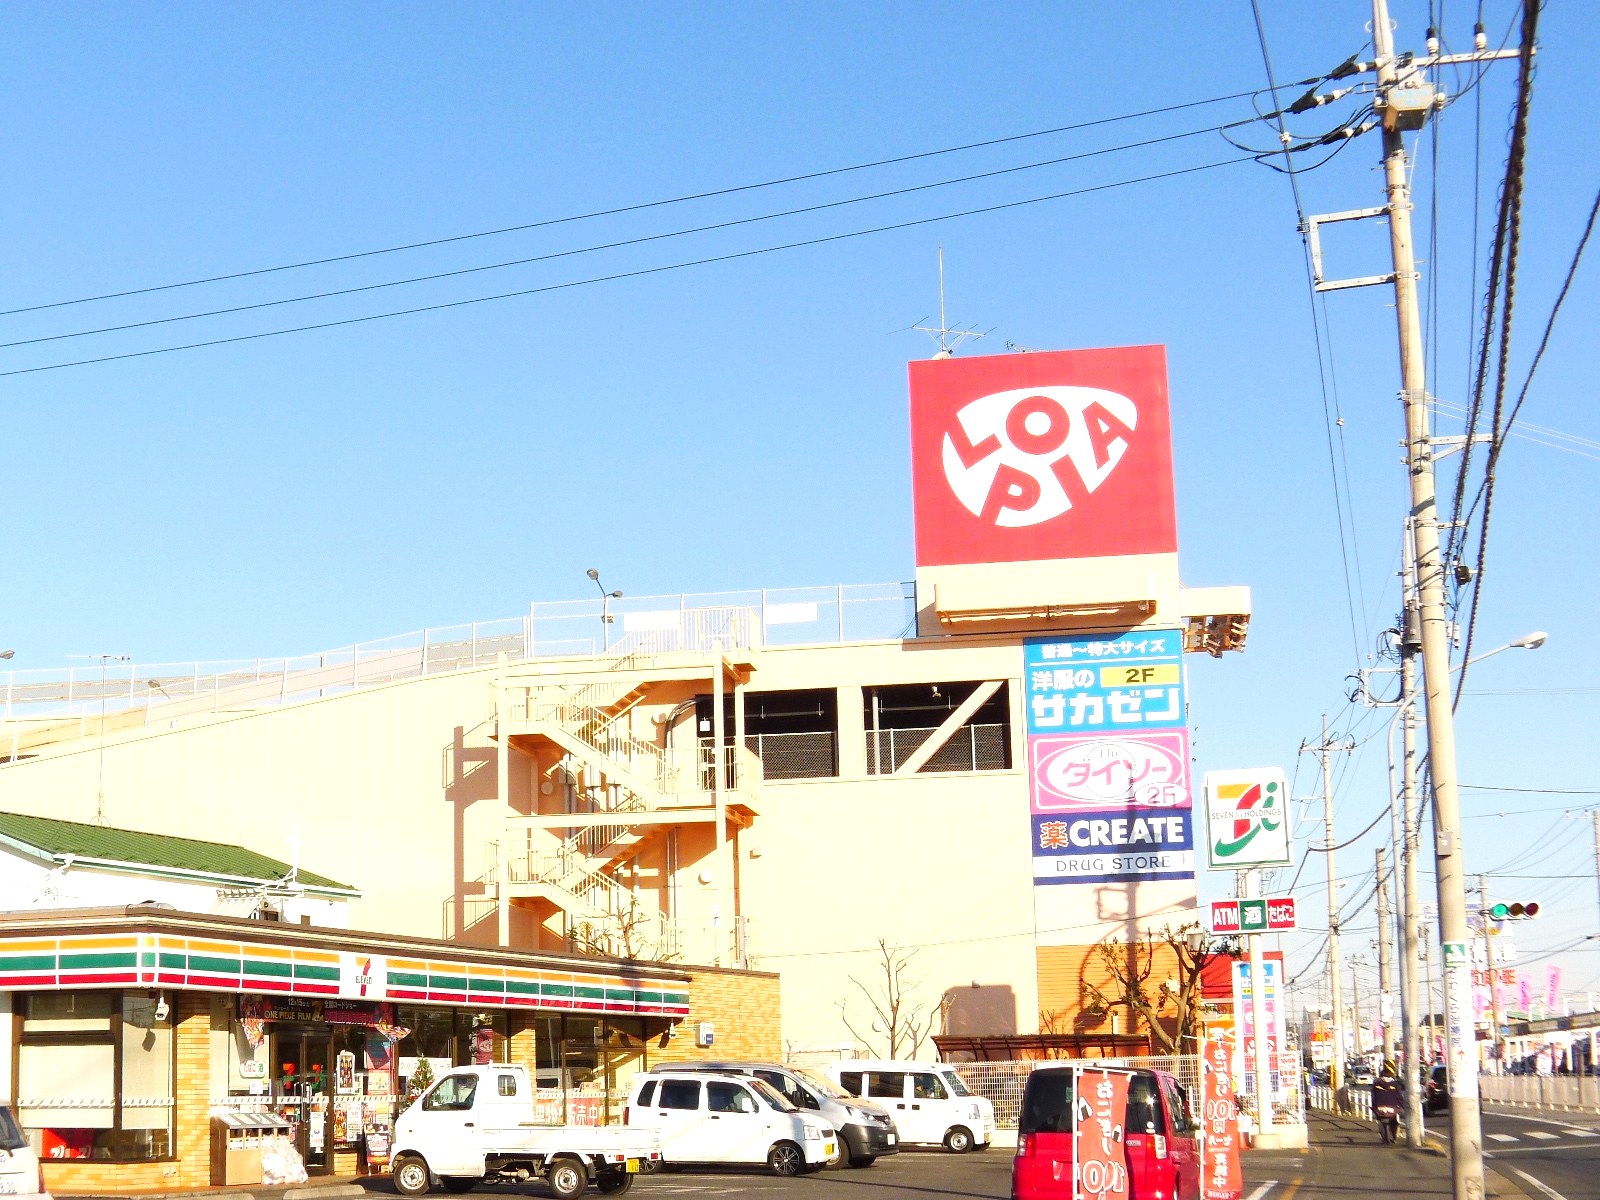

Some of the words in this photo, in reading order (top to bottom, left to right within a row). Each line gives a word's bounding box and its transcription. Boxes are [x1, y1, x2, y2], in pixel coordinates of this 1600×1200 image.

[1032, 669, 1095, 691] 洋服の
[1125, 667, 1155, 684] 2F
[1031, 688, 1180, 727] サカゼン
[1062, 757, 1167, 787] ダイソー
[1147, 785, 1176, 804] 2F
[1244, 808, 1282, 818] HOLDINGS
[1040, 821, 1068, 849] 薬
[1069, 816, 1185, 847] CREATE
[1056, 858, 1104, 872] DRUG
[1112, 855, 1172, 870] STORE
[1213, 906, 1239, 926] ATM
[1244, 906, 1262, 925] 酒
[1267, 905, 1295, 923] たばこ
[279, 1011, 295, 1020] PIECE
